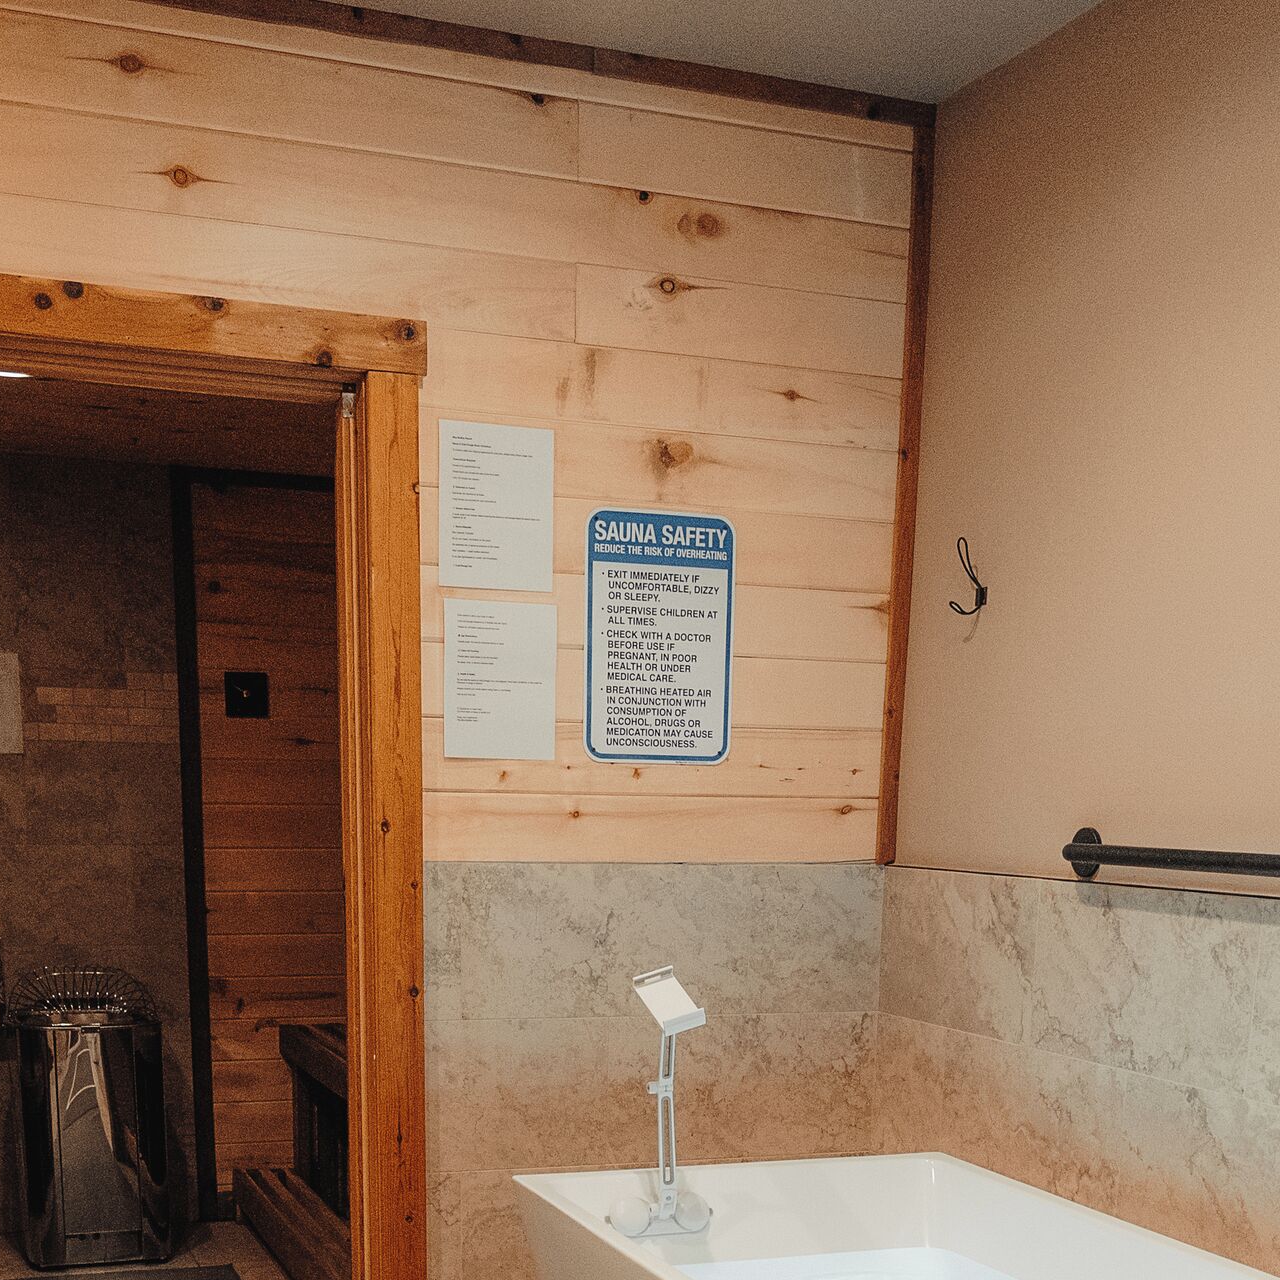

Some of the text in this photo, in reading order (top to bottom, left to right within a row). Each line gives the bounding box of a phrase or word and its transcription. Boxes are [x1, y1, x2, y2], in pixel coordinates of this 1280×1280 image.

[595, 520, 727, 548] SAUNA SAFETY
[595, 543, 727, 560] REDUCE THE RISK OF OVERHEATING
[608, 570, 700, 583] EXIT IMMEDIATELY IF
[608, 581, 719, 594] UNCOMFORTABLE, DIZZY
[608, 592, 660, 602] OR SLEEPY.
[607, 605, 718, 619] SUPERVISE CHILDREN AT
[608, 616, 657, 626] ALL TIMES.
[607, 630, 637, 638] CHECK
[641, 631, 662, 640] WITH
[674, 633, 711, 642] DOCTOR
[608, 641, 675, 651] BEFORE USE IF
[608, 651, 697, 662] PREGNANT, IN POOR
[608, 662, 691, 672] HEALTH OR UNDER
[607, 672, 676, 682] MEDICAL CARE.
[606, 686, 711, 697] BREATHING HEATED AIR
[618, 697, 681, 706] CONJUNCTION
[684, 699, 706, 707] WITH
[607, 707, 672, 716] CONSUMPTION
[607, 717, 700, 728] ALCOHOL, DRUGS OR
[607, 728, 660, 736] MEDICATION
[684, 730, 713, 738] CAUSE
[606, 738, 697, 748] UNCONSCIOUSNESS.
